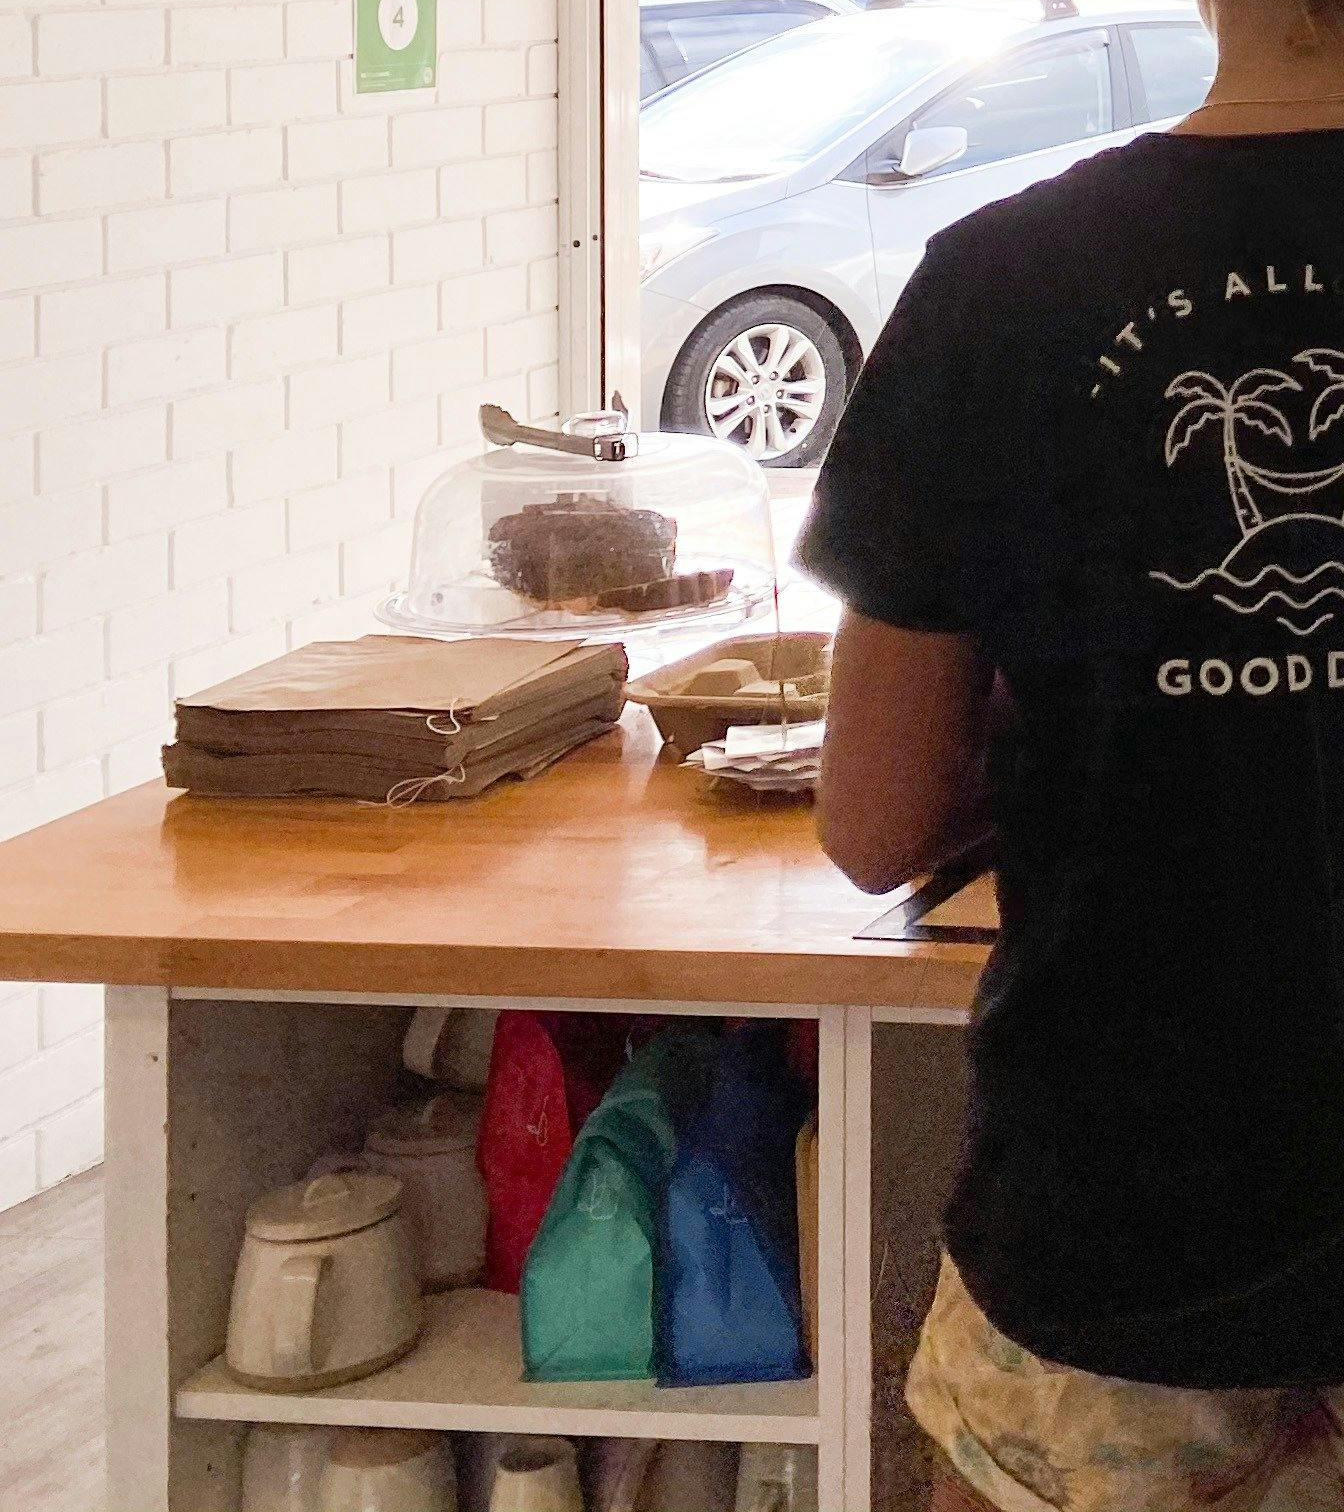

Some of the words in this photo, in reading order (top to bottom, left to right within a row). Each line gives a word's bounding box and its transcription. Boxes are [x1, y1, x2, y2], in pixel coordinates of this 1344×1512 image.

[391, 5, 405, 29] 4
[1100, 289, 1193, 376] IT'S
[1224, 264, 1323, 301] ALL
[1156, 656, 1312, 696] GOOD
